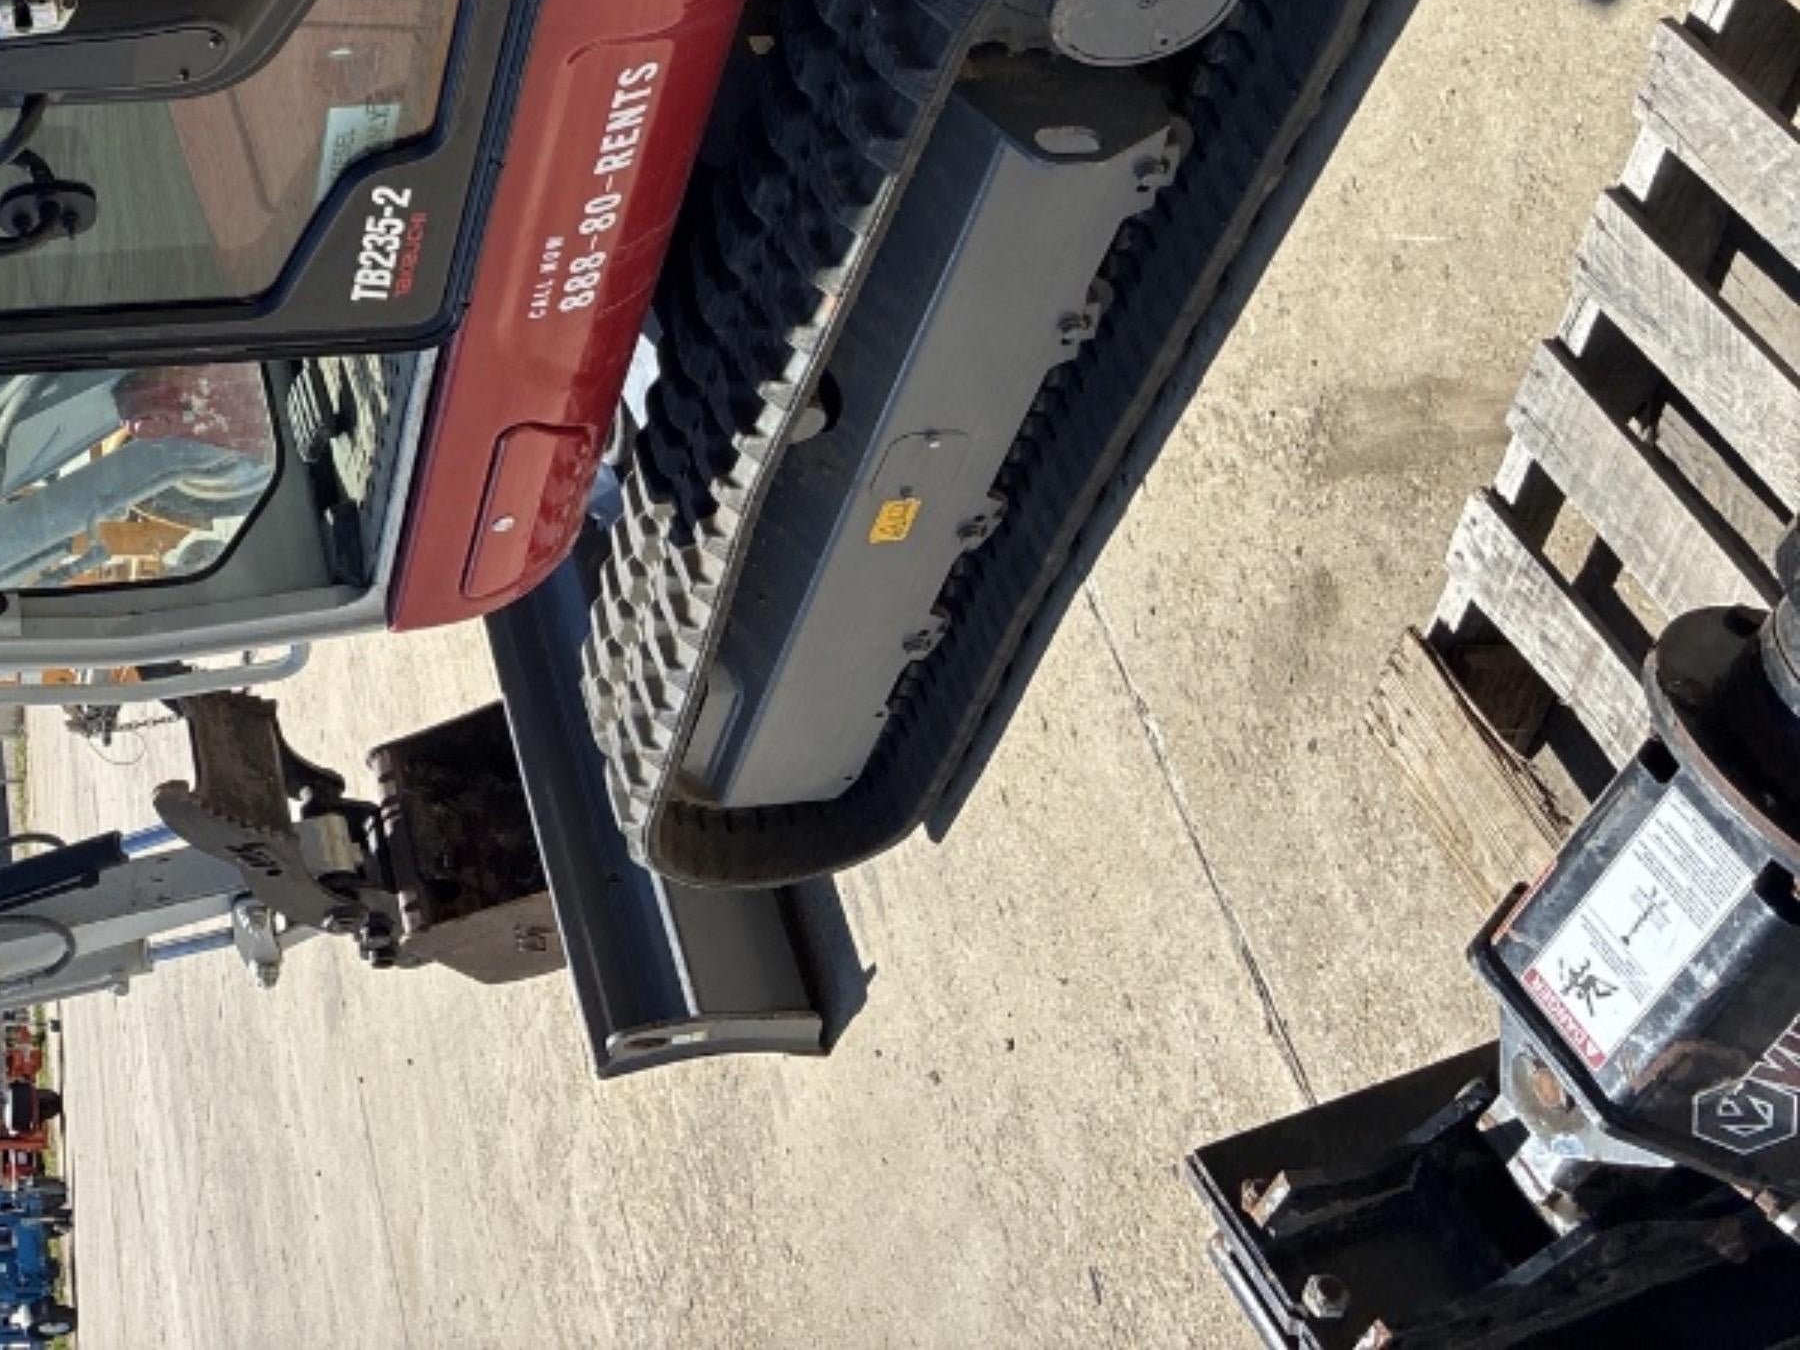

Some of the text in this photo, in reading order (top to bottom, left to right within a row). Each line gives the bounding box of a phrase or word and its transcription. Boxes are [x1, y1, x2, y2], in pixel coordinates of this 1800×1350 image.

[349, 186, 412, 302] TB235-2
[556, 61, 660, 313] 888-80-RENTS
[527, 236, 565, 319] CALL NOW
